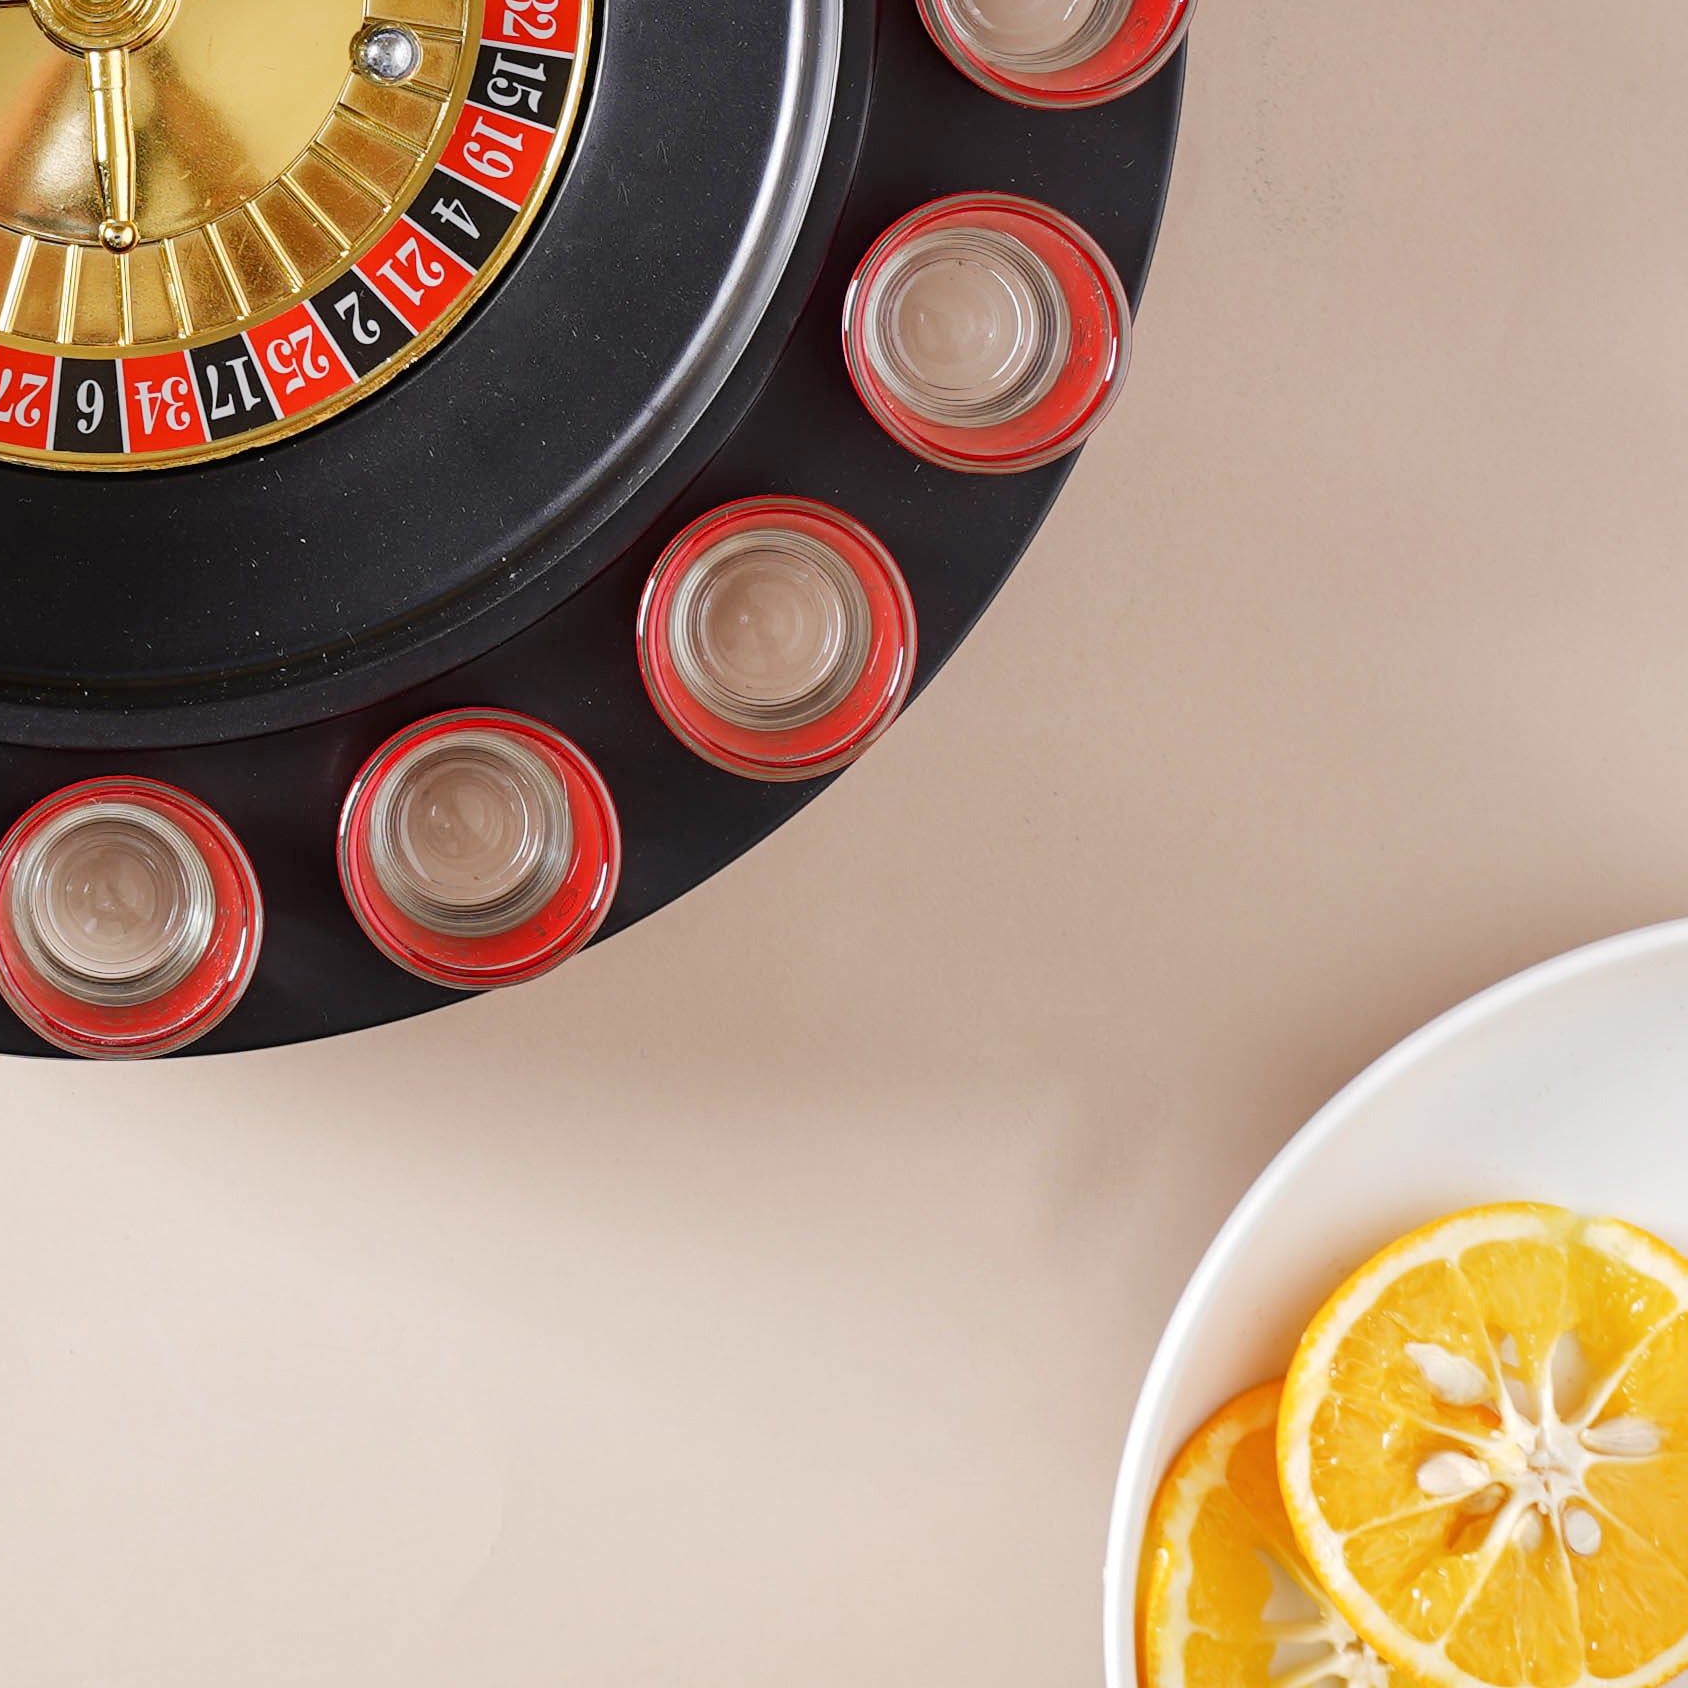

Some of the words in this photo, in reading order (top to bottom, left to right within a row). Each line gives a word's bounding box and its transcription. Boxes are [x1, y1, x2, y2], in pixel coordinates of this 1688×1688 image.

[486, 52, 547, 113] 15
[463, 116, 523, 179] 19
[430, 197, 481, 240] 4
[375, 237, 445, 306] 21
[333, 291, 381, 345] 2
[206, 356, 262, 420] 17
[266, 324, 330, 395] 25
[76, 379, 104, 434] 6
[134, 376, 191, 435] 34
